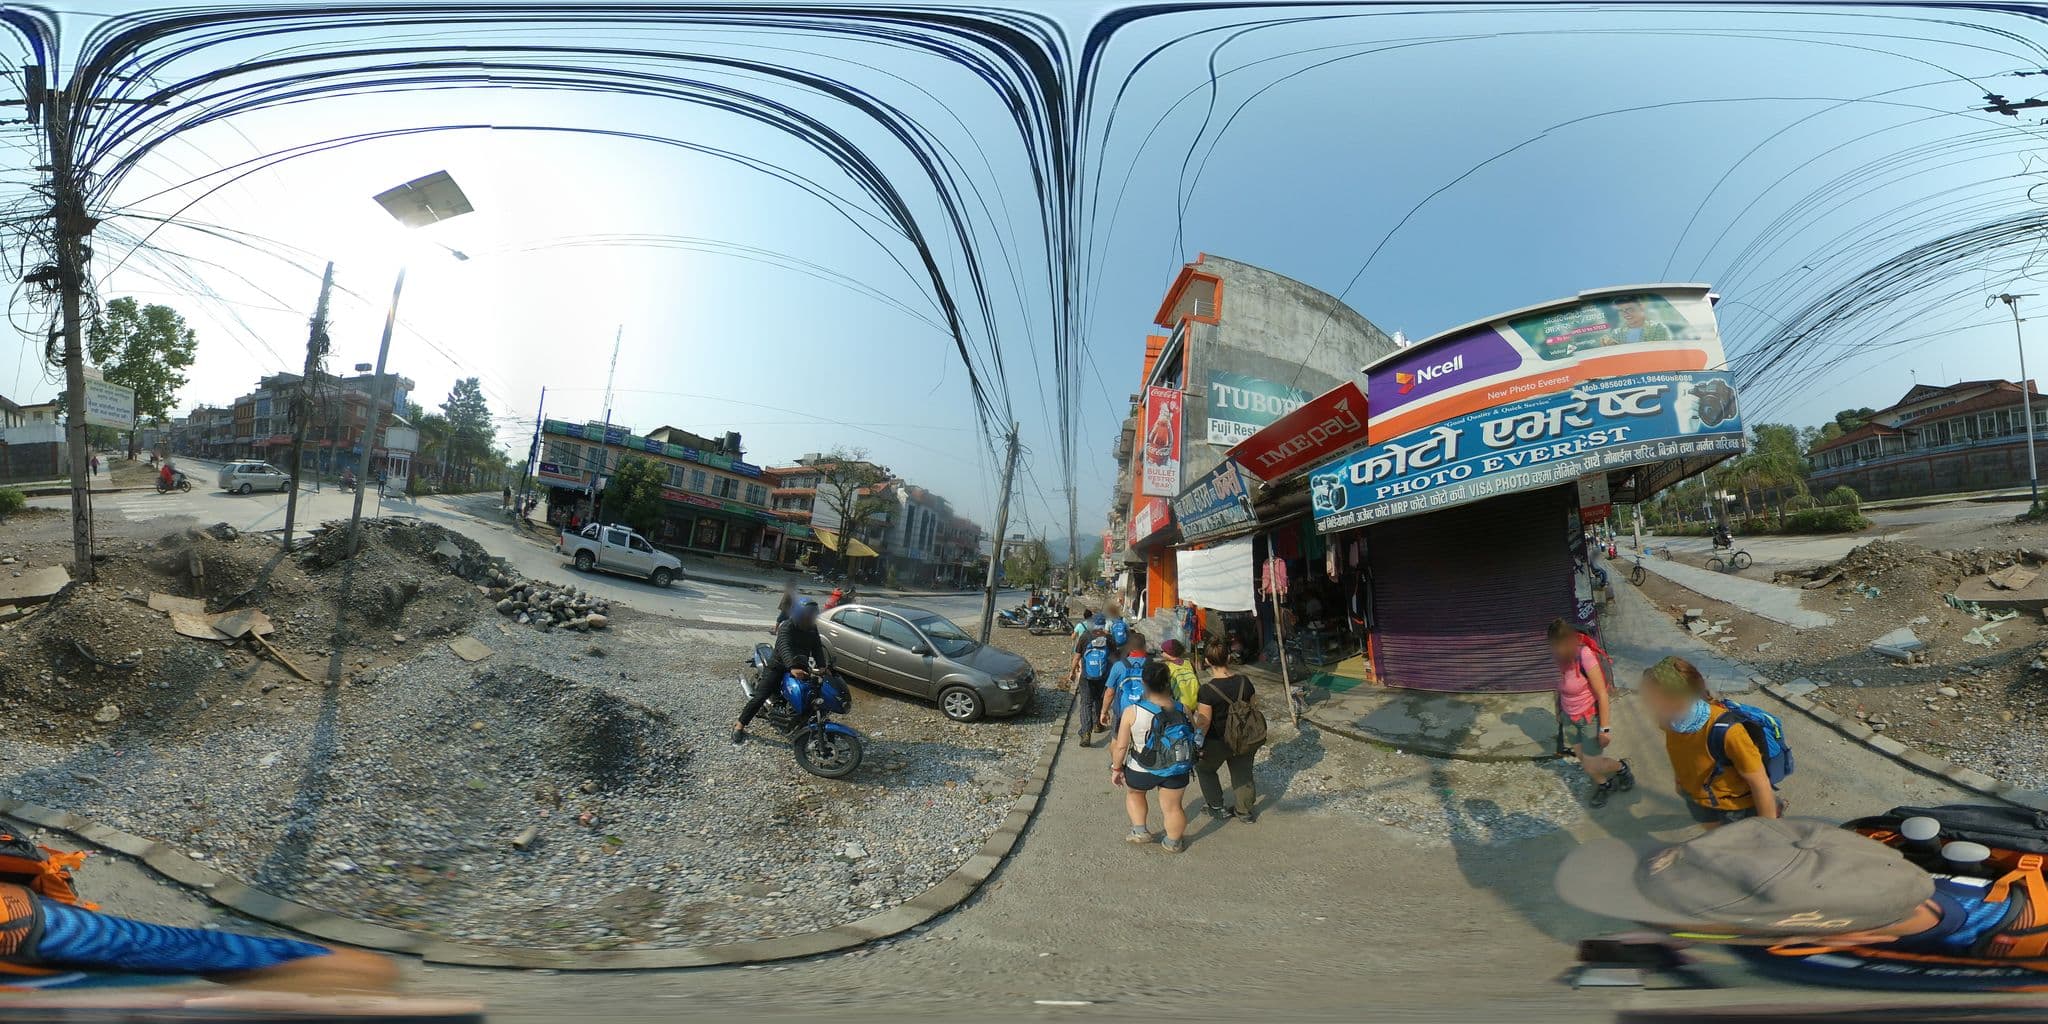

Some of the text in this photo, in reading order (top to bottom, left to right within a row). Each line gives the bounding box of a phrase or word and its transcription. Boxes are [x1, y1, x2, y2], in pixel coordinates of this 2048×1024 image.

[1417, 355, 1463, 384] Ncell
[1487, 376, 1569, 400] New Photo Everest
[1501, 404, 1522, 413] Quick
[1211, 420, 1231, 437] Fuji
[1349, 426, 1462, 485] फोटो
[1376, 464, 1472, 500] PHOTO
[1482, 426, 1631, 474] EVEREST
[1148, 468, 1175, 477] BULLET
[1391, 501, 1408, 514] MRP
[1469, 484, 1493, 498] VISA
[1496, 473, 1530, 492] PHOTO
